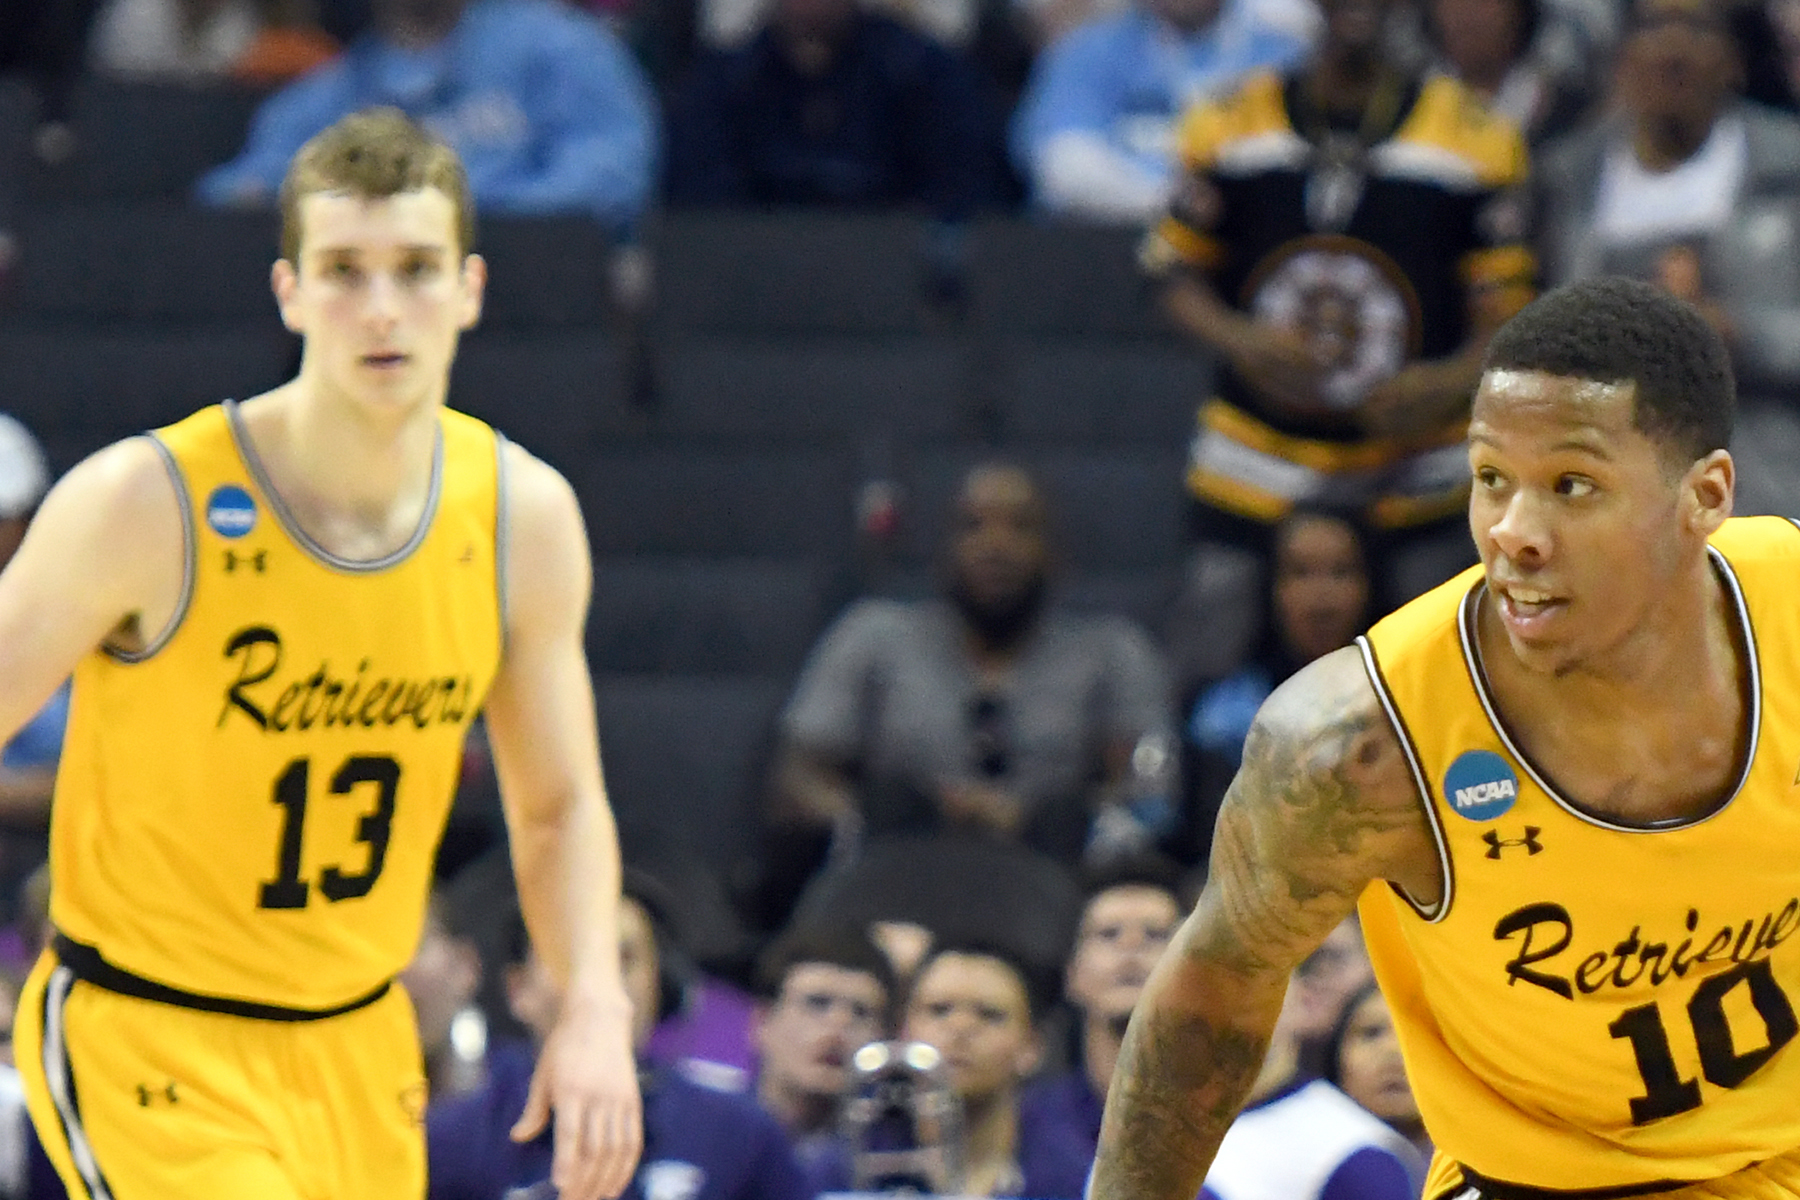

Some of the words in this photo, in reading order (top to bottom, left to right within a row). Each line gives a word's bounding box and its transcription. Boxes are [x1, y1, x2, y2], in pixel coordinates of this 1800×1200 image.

[257, 754, 403, 910] 13
[1455, 779, 1516, 809] NCAA
[1607, 955, 1800, 1128] 10
